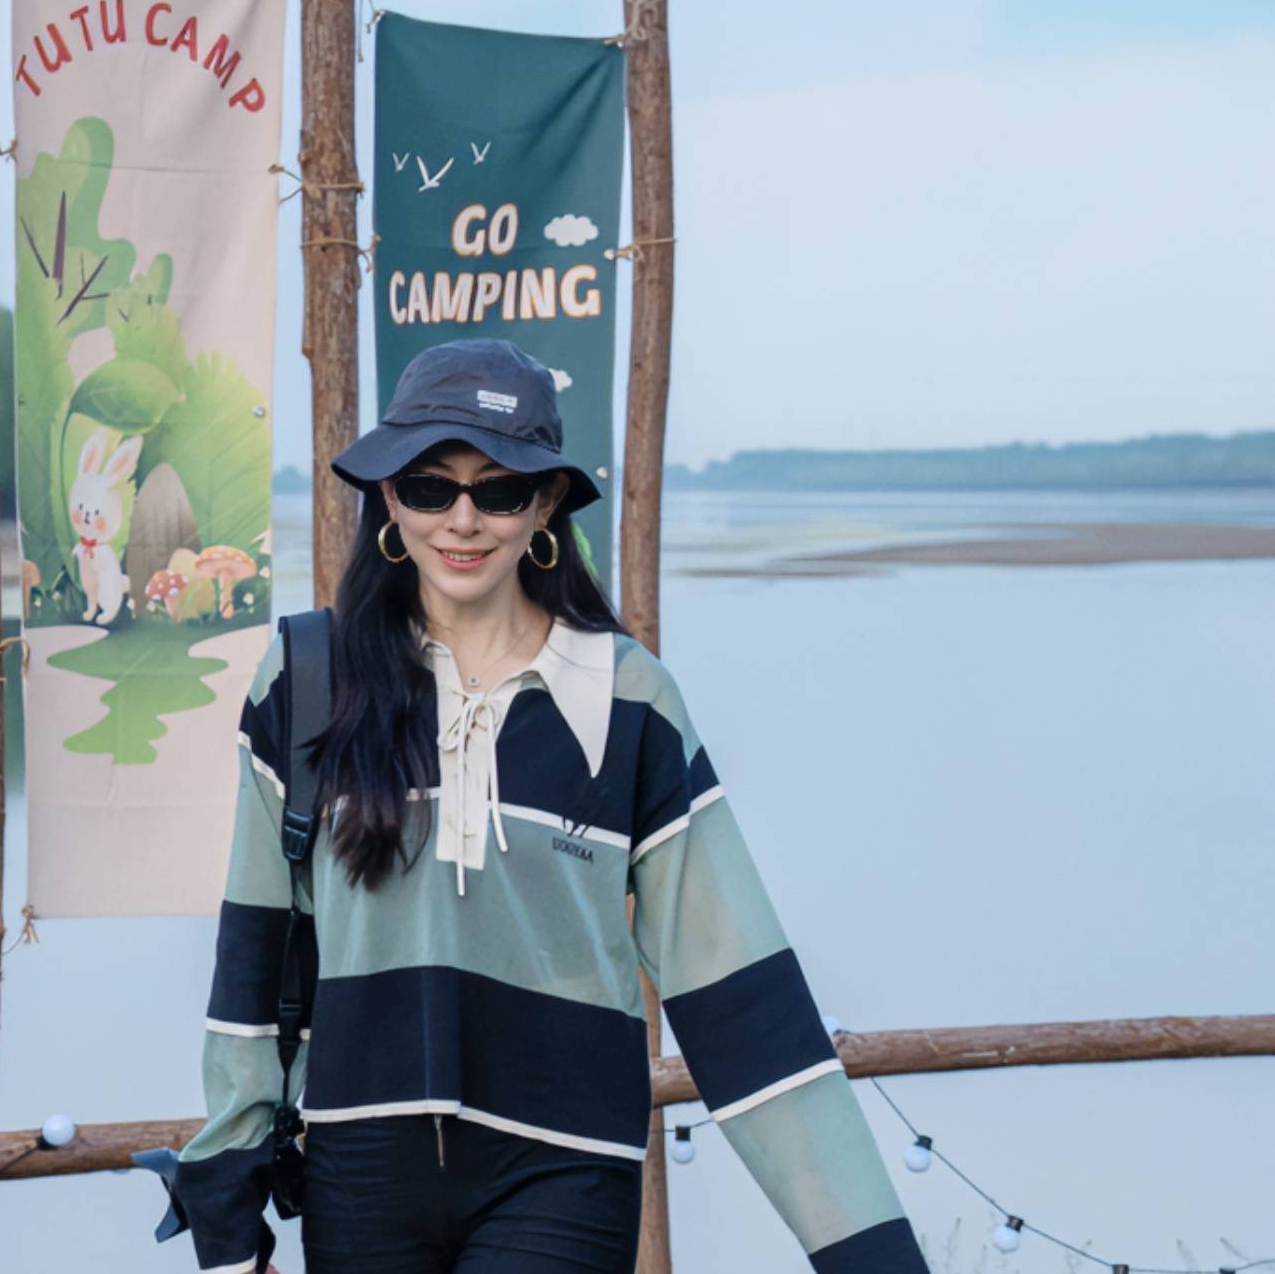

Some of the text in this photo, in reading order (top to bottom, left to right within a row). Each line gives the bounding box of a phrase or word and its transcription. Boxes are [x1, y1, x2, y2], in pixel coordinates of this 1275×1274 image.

[145, 1, 266, 113] CAMP
[451, 203, 518, 257] GO
[389, 263, 602, 325] CAMPING
